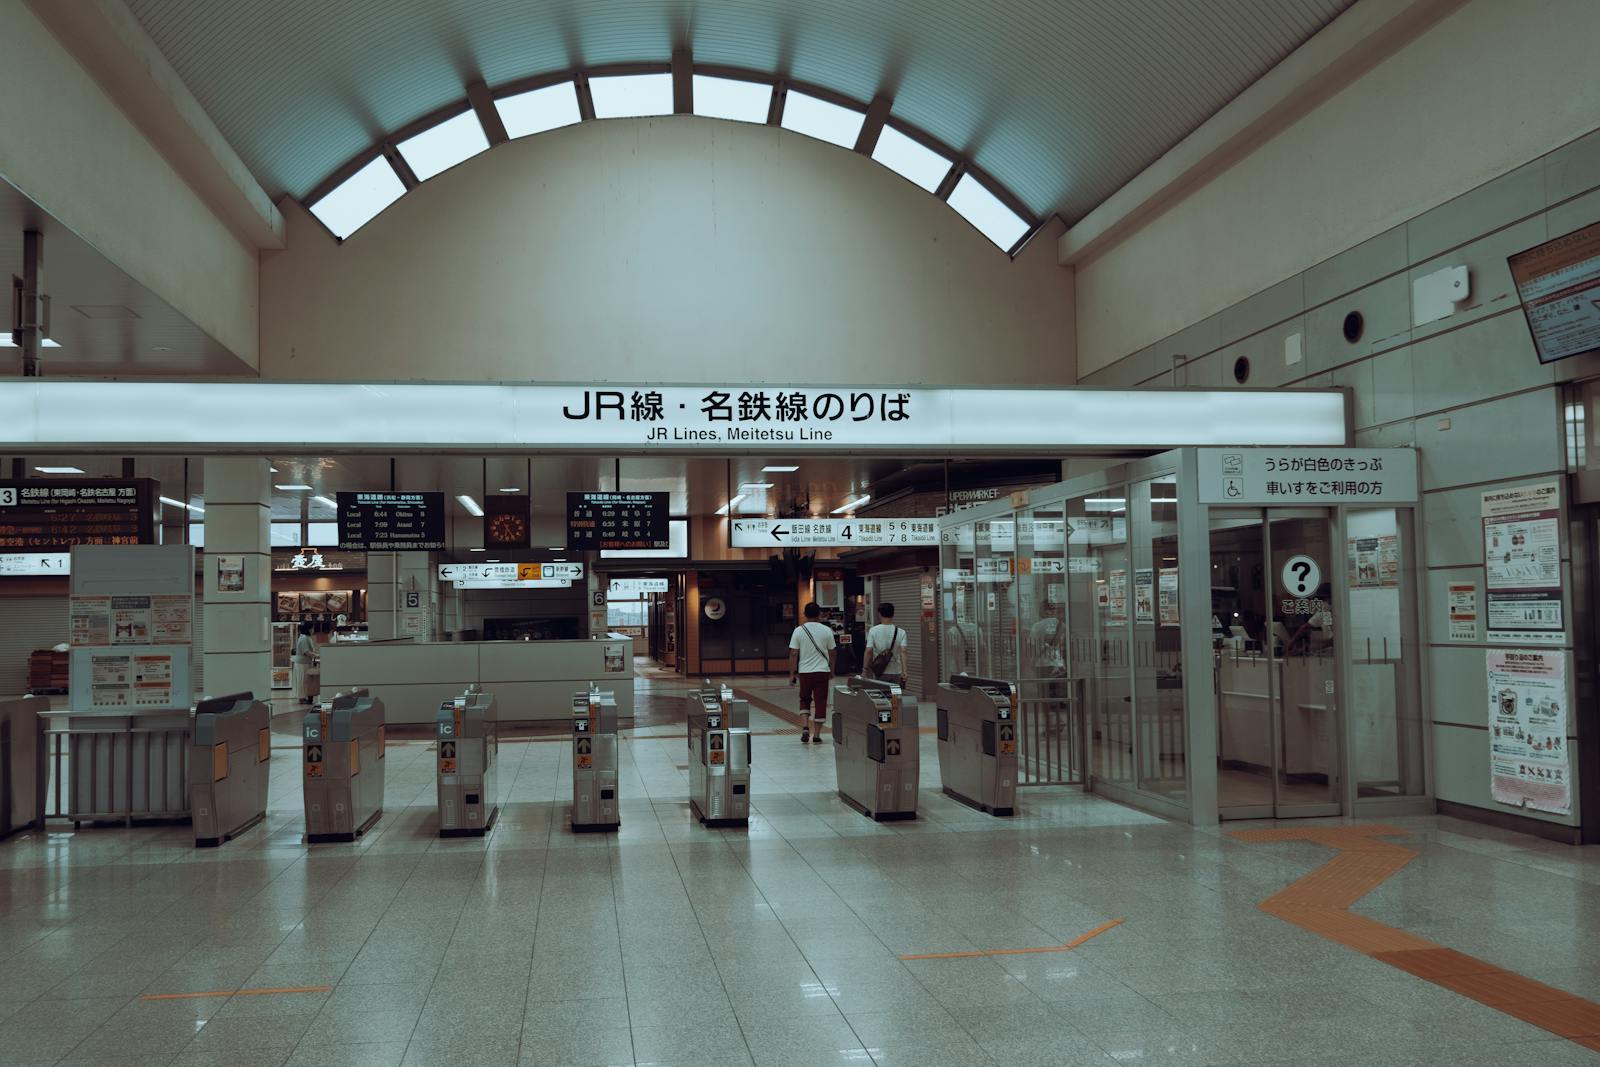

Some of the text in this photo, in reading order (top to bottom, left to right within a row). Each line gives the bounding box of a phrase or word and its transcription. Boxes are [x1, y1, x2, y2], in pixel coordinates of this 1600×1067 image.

[563, 390, 911, 421] JR線・名鉄線のりば
[647, 428, 833, 442] JR Lines, Meitetsu Line
[1264, 458, 1383, 472] うらが白色のきっぷ
[1266, 482, 1383, 495] 車いすをご利用の方
[2, 490, 12, 504] 3
[889, 522, 907, 530] 5 6
[841, 526, 852, 540] 4
[889, 534, 907, 542] 7 8
[58, 559, 62, 568] 1
[408, 594, 418, 606] 5
[595, 592, 604, 604] 6
[1282, 599, 1324, 614] ご案内
[306, 726, 319, 738] ic
[440, 723, 452, 734] ic
